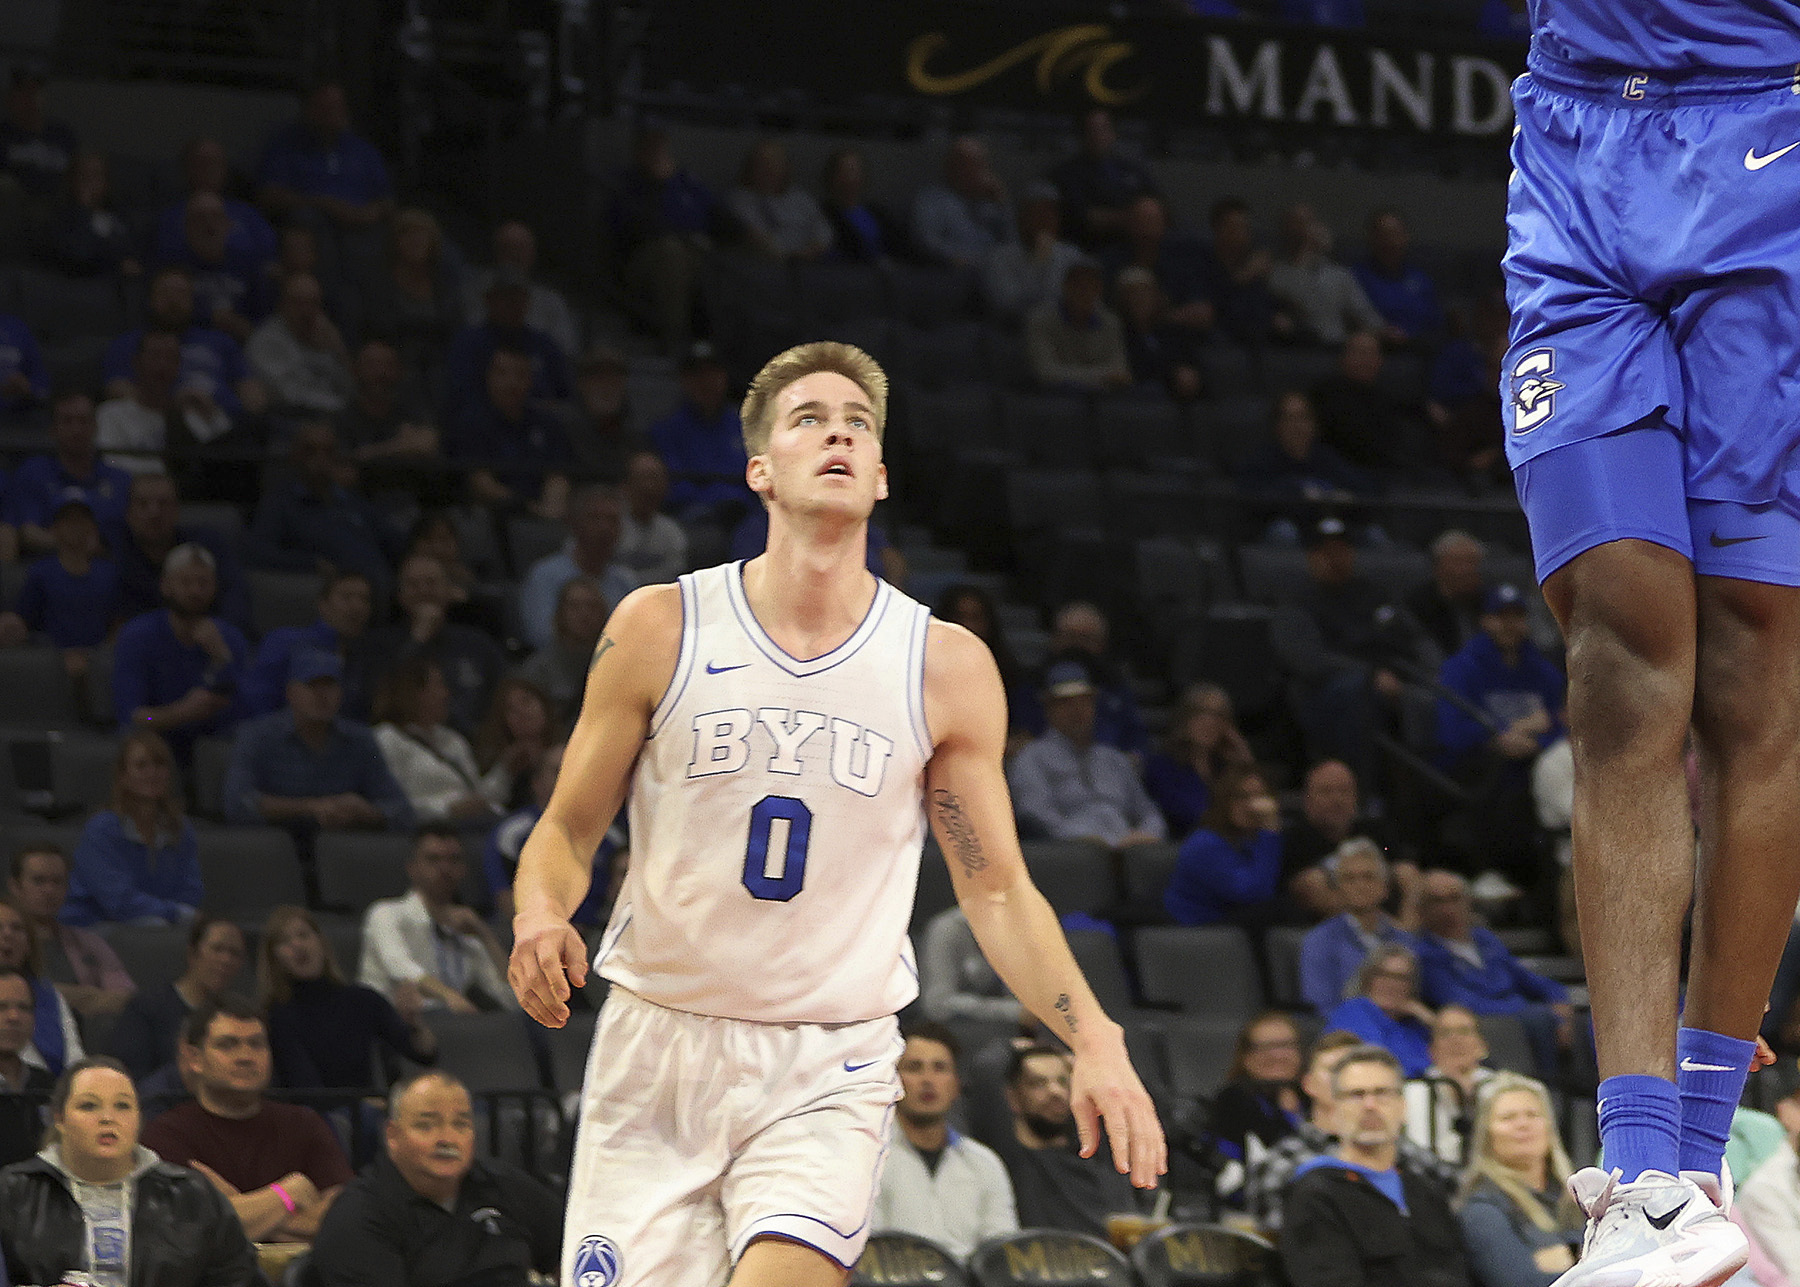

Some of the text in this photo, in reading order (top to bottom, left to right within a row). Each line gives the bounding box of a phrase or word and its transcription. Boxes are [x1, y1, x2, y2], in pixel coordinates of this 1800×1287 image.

[1205, 35, 1513, 136] MAND
[686, 707, 895, 798] BYU
[741, 794, 812, 902] 0
